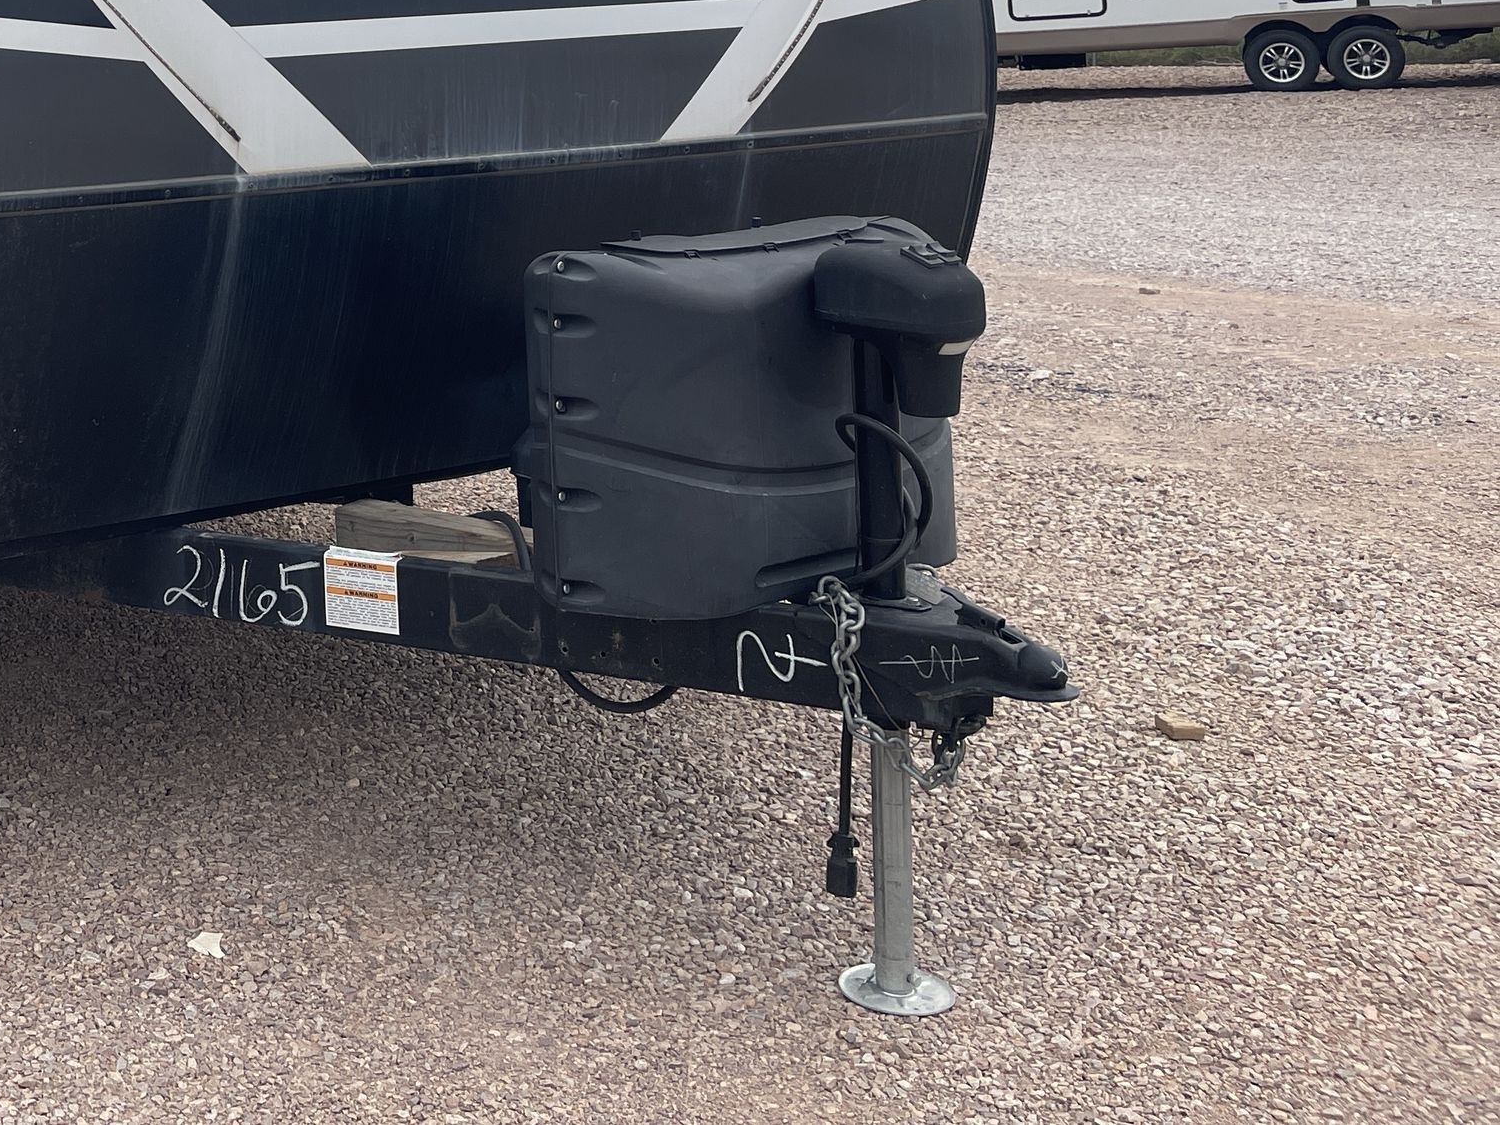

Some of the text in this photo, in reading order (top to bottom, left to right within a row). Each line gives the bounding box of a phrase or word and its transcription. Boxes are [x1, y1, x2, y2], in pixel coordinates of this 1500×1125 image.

[348, 561, 378, 570] WARNING
[164, 545, 321, 626] 2165
[349, 590, 379, 599] WARNING
